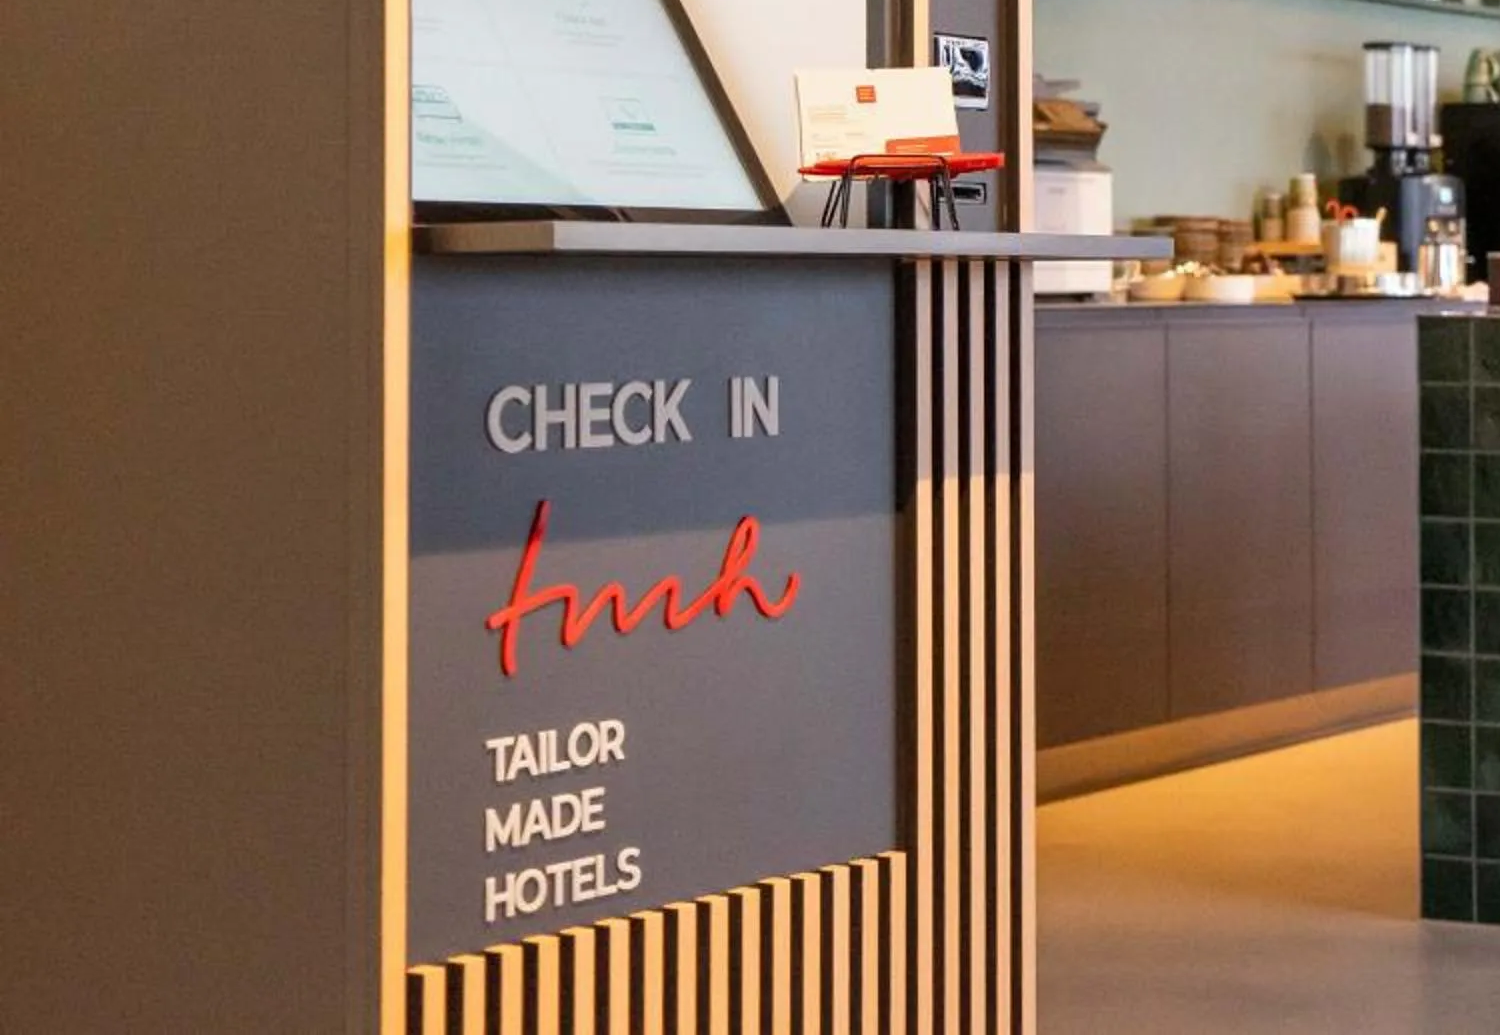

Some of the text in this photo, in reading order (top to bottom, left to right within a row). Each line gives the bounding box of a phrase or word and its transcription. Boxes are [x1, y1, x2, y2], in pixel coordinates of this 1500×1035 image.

[487, 375, 779, 453] CHECK IN
[486, 719, 625, 782] TAILOR
[485, 787, 606, 852] MADE
[485, 847, 642, 922] HOTELS
